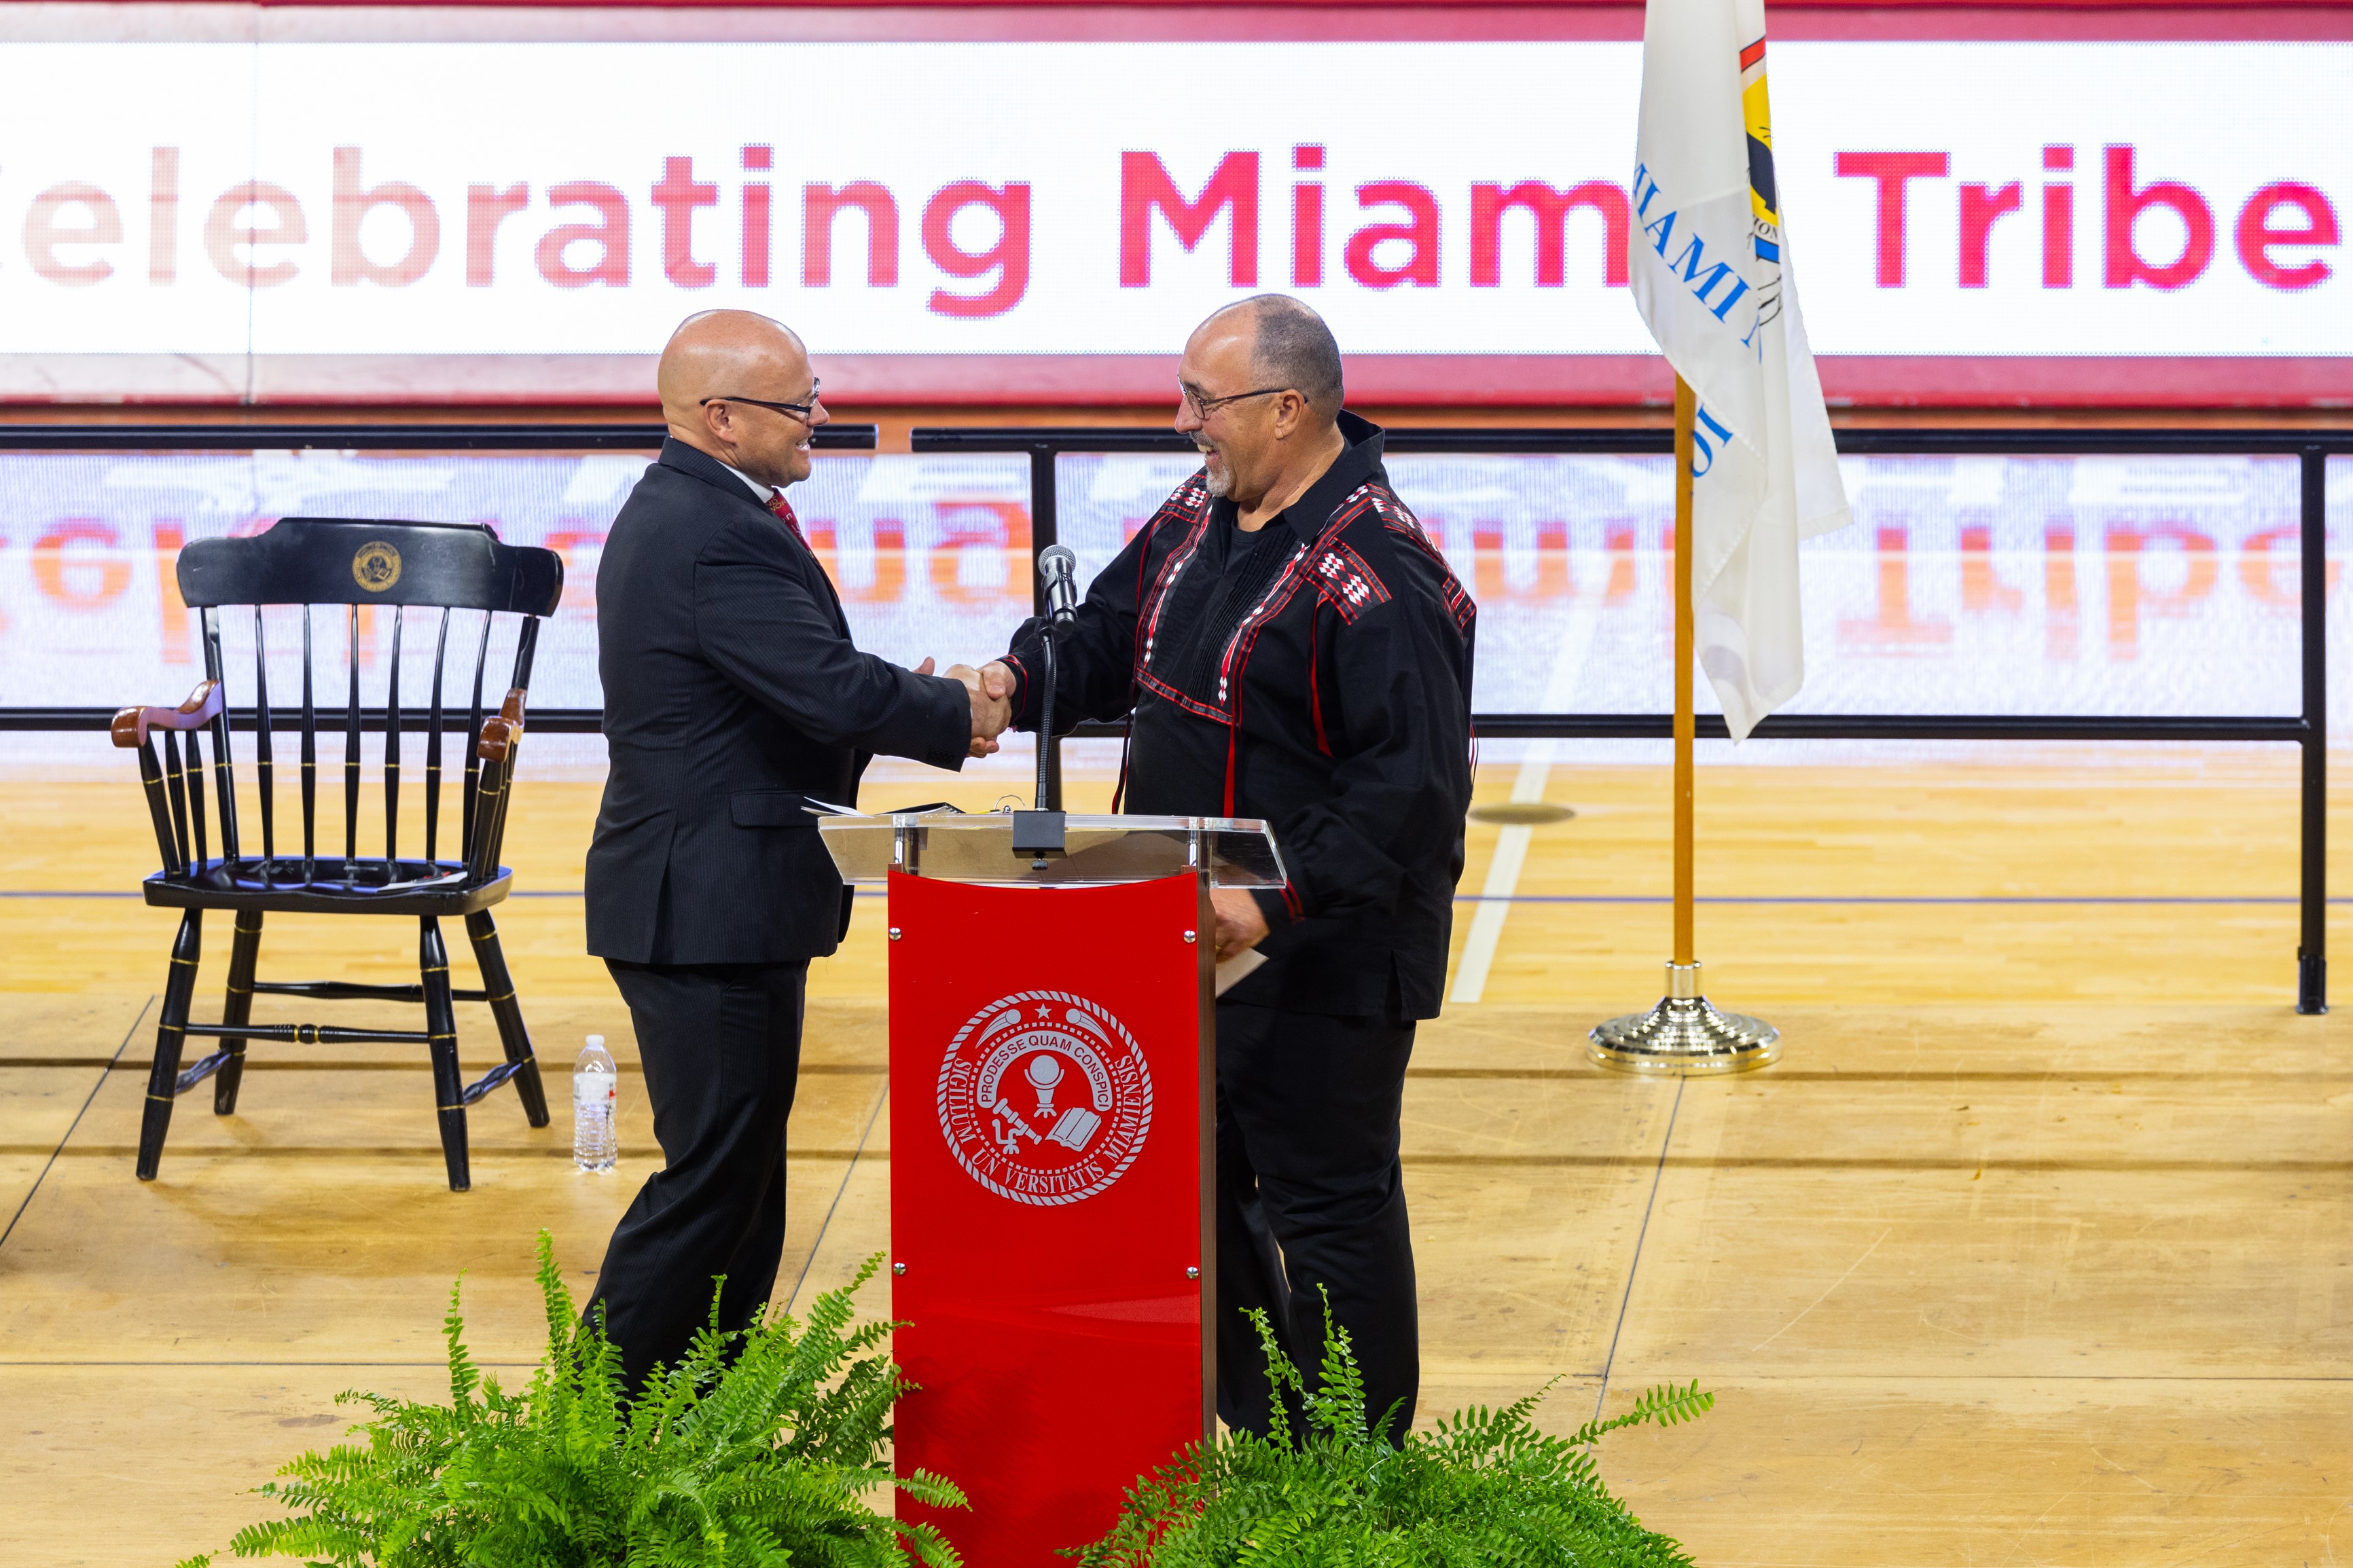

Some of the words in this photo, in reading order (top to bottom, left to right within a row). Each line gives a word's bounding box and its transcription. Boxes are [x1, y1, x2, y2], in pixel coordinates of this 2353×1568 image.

[0, 144, 1032, 320] elebrating
[1119, 143, 1630, 291] Miam
[1834, 143, 2342, 291] Tribe
[948, 1058, 977, 1144] SIGILLUM
[1103, 1055, 1142, 1164] MIAMIENSIS
[981, 1039, 1027, 1102] PRODESSE
[1028, 1035, 1073, 1051] QUAM
[1074, 1046, 1109, 1108] CONSPICI
